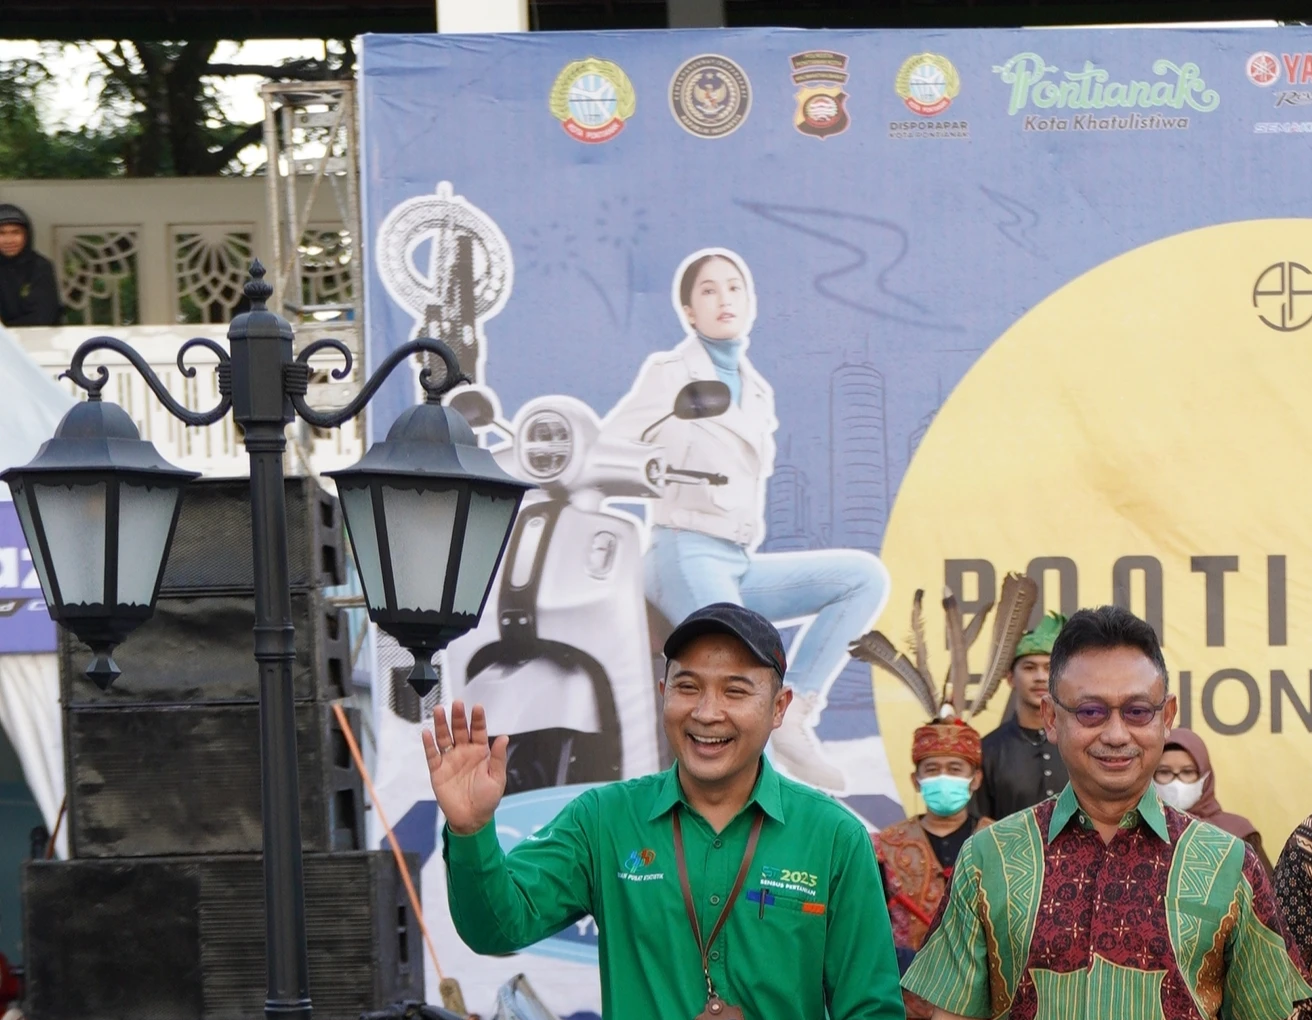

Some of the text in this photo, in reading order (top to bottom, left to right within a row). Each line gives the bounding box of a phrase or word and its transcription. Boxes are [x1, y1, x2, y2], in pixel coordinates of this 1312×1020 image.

[992, 52, 1220, 115] Pontianak
[889, 121, 968, 131] DISPORAPAR
[1024, 112, 1189, 131] Kota Khatulistiwa
[780, 869, 818, 887] 2023
